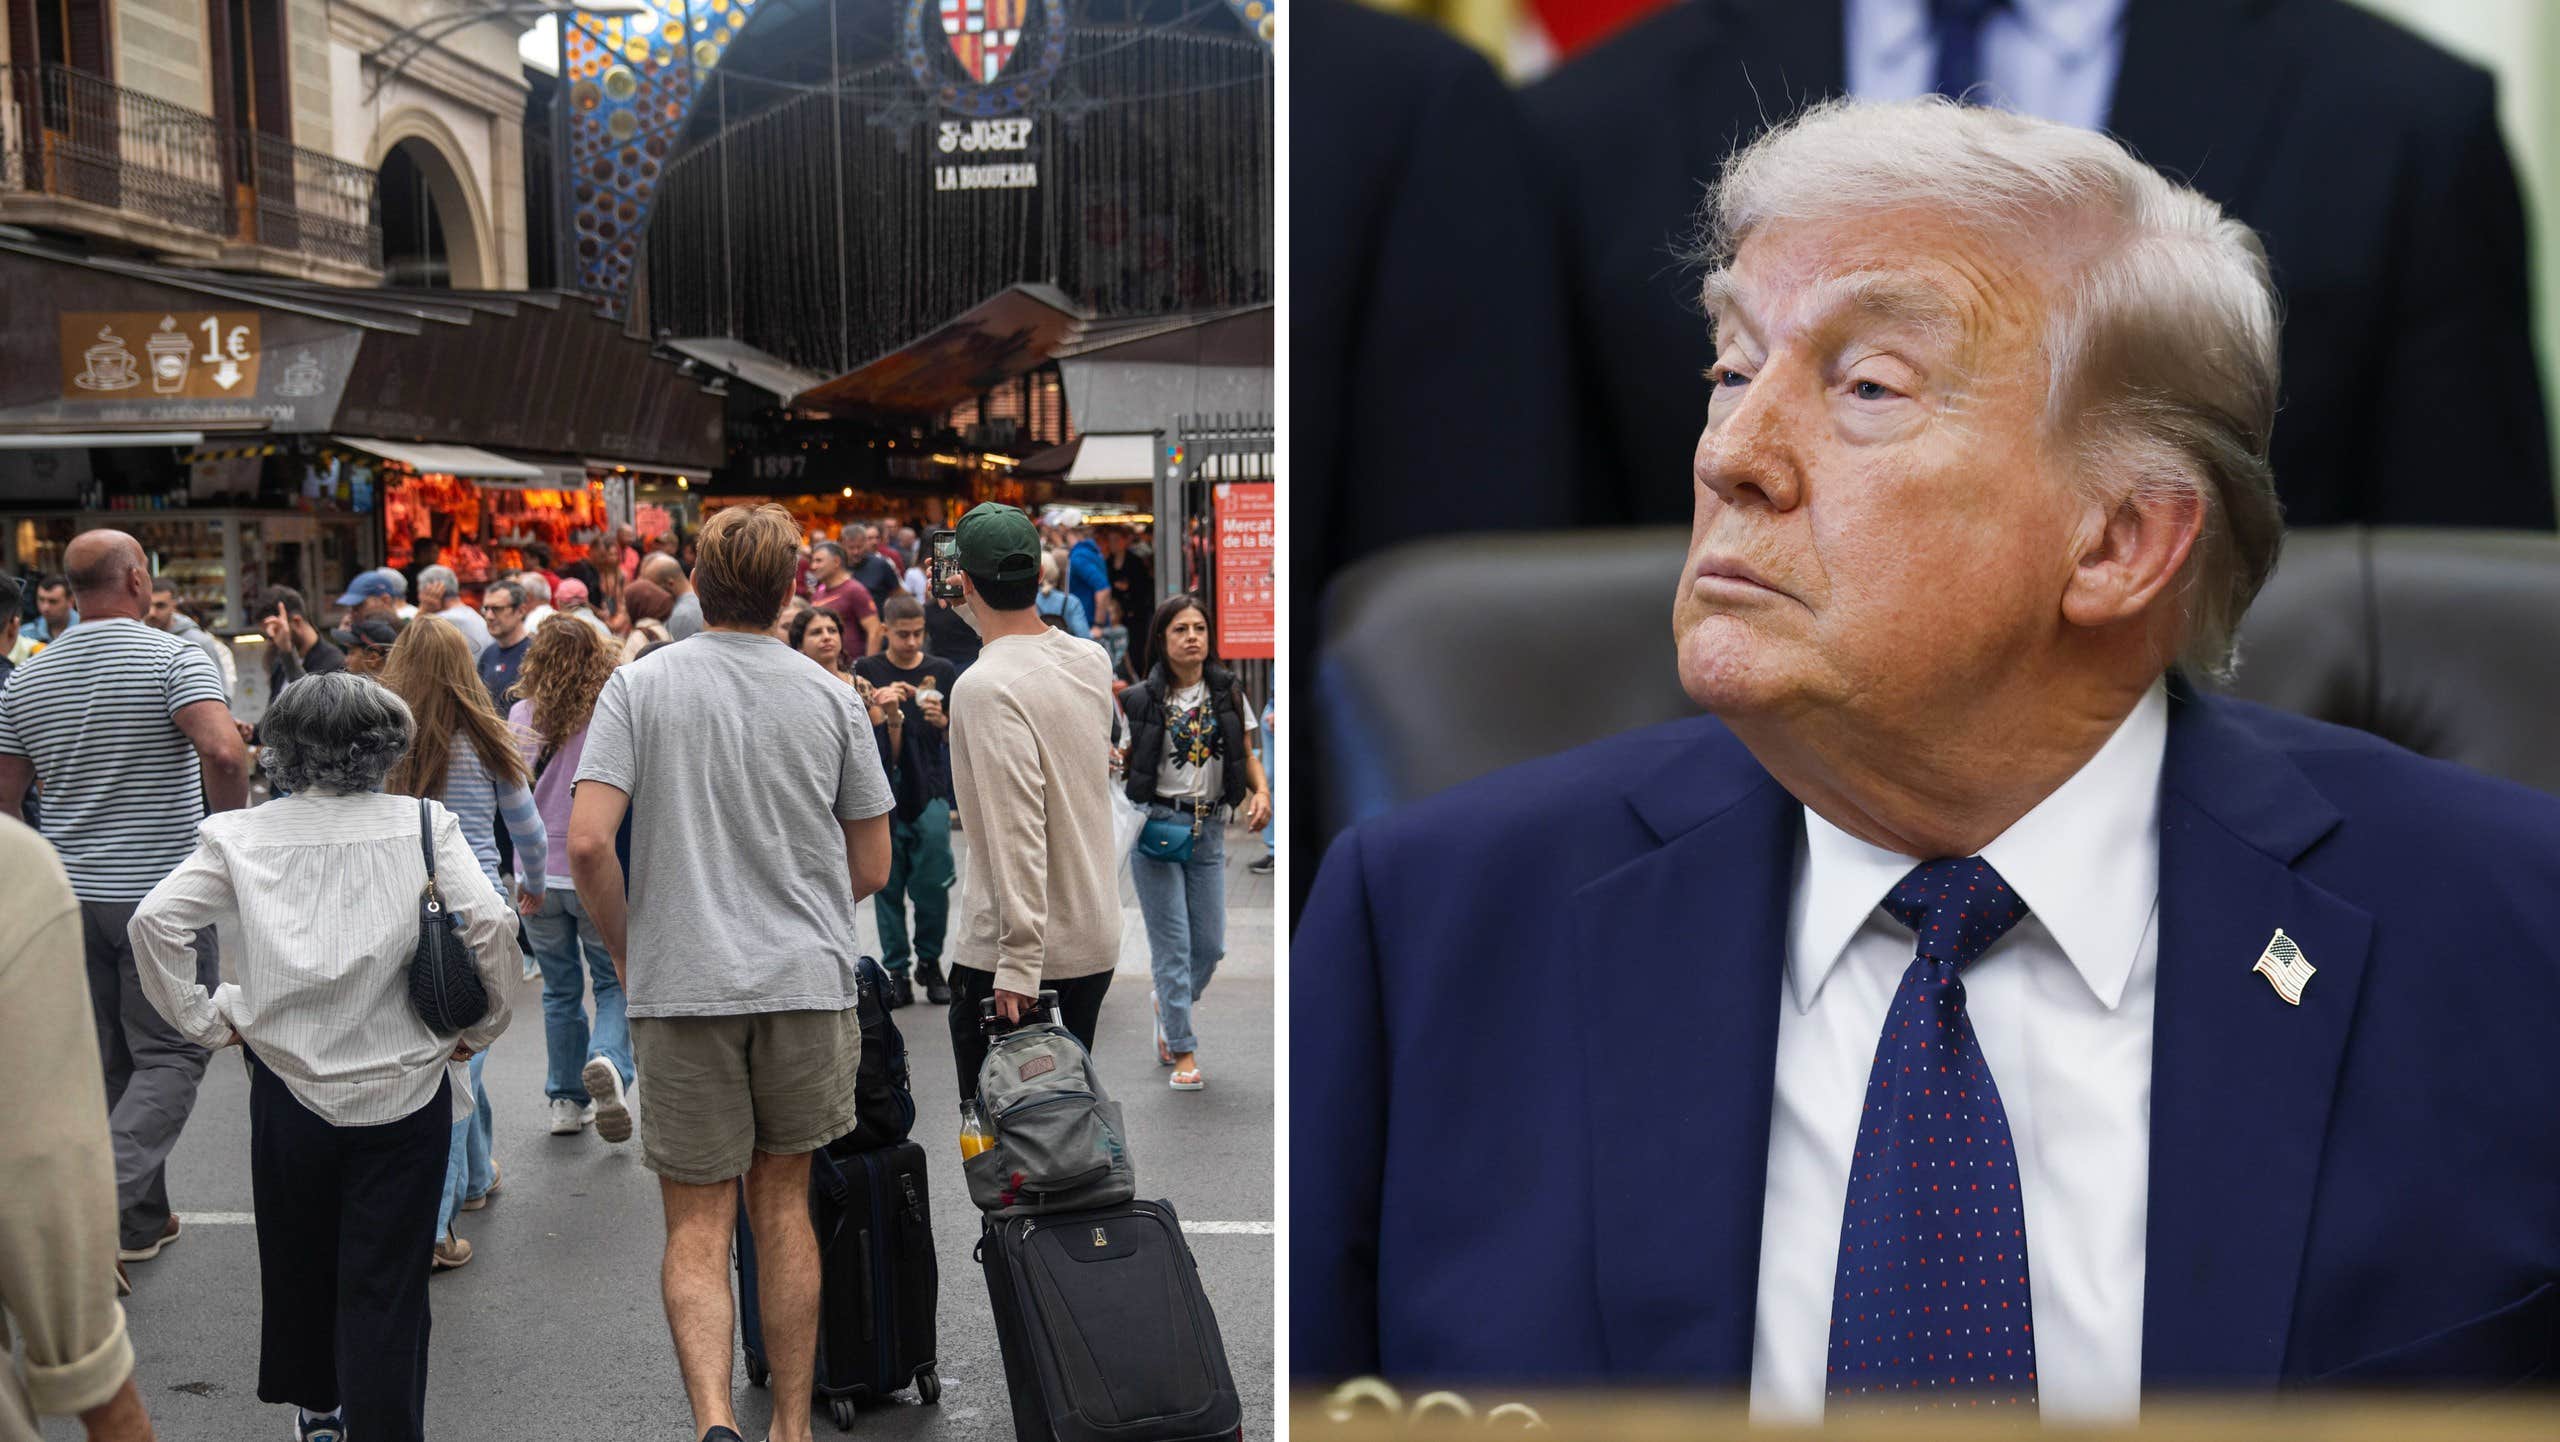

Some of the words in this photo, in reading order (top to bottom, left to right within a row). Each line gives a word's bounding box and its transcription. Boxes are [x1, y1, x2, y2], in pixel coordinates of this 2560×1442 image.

[960, 117, 1033, 152] JOSEP
[935, 165, 958, 191] LA
[200, 315, 251, 363] 1€
[753, 455, 807, 479] 1897
[1223, 518, 1272, 533] Mercat
[1222, 535, 1241, 548] de
[1242, 534, 1257, 548] la
